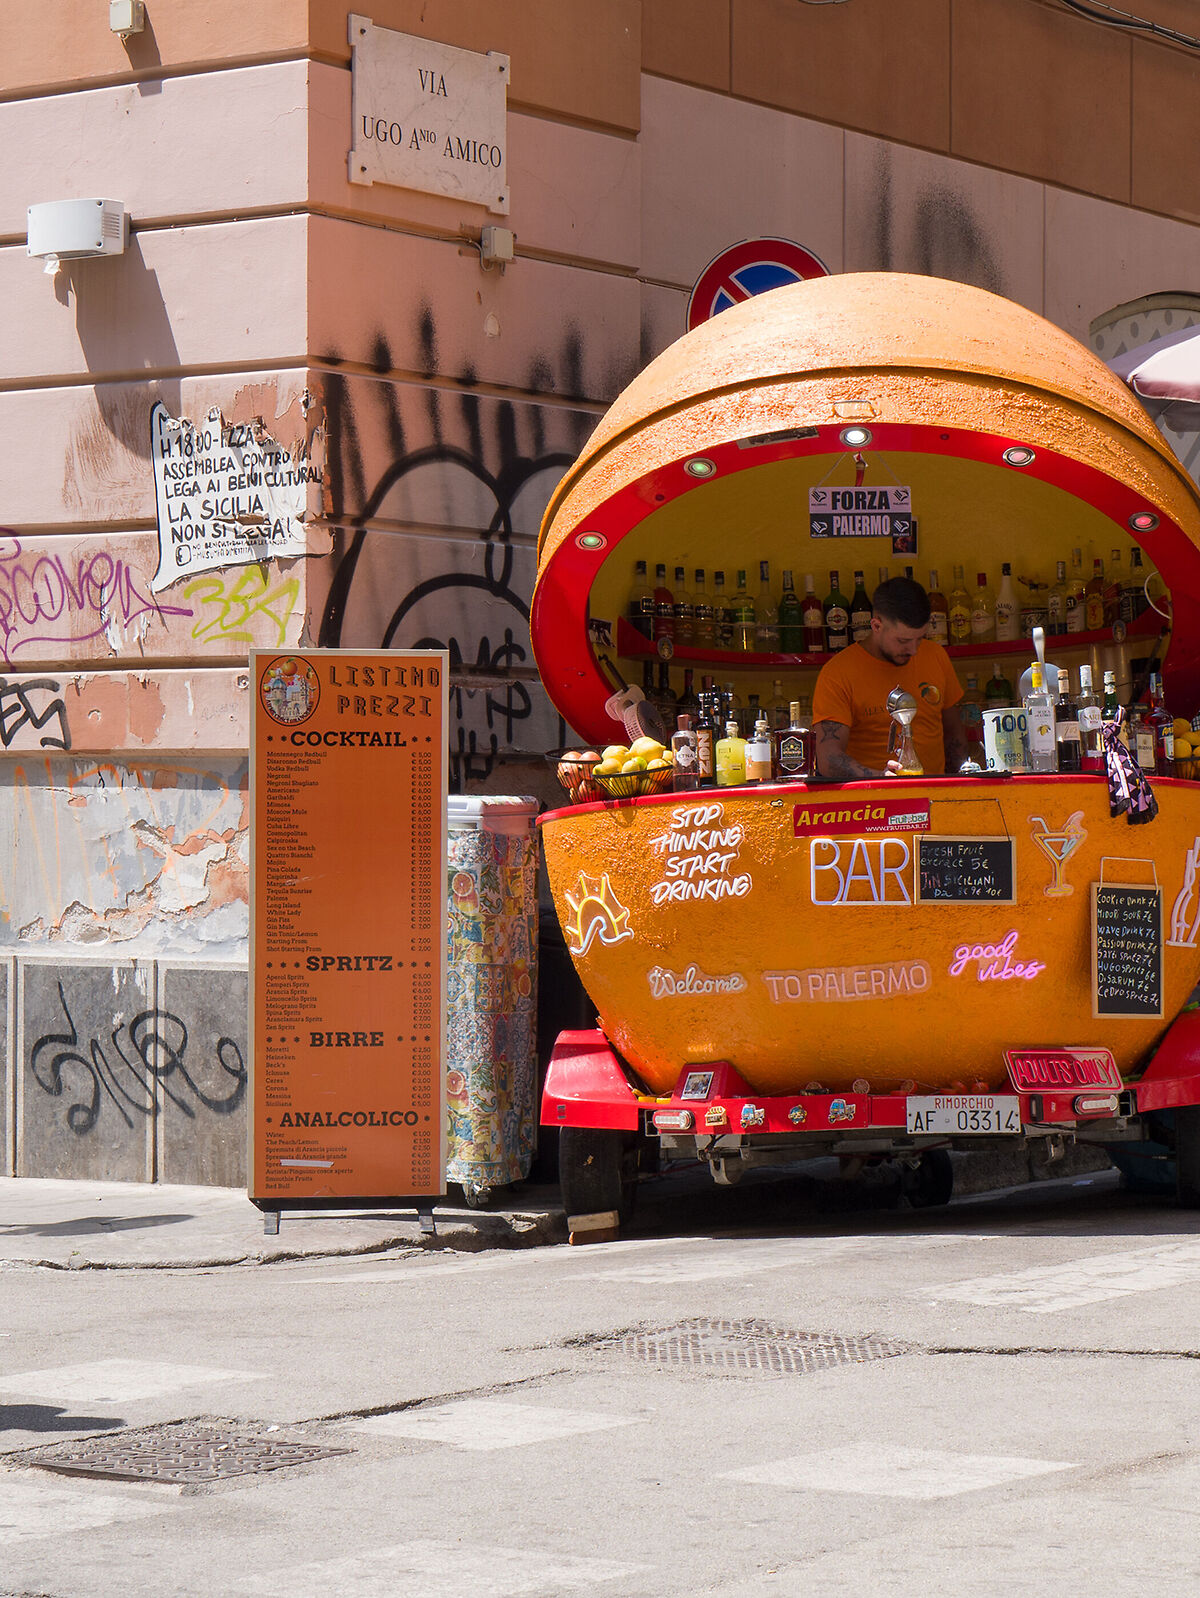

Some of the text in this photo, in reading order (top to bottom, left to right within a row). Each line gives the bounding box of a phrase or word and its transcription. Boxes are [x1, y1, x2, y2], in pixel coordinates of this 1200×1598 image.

[418, 68, 448, 97] VIA
[362, 115, 402, 145] UGO
[443, 136, 502, 168] AMICO
[163, 455, 236, 481] ASSEMBLEA
[164, 480, 201, 500] LEGA
[831, 490, 891, 511] FORZA
[167, 494, 264, 523] LA SICILIA
[171, 524, 206, 544] NON
[832, 514, 891, 536] PALERMO
[329, 665, 440, 688] LISTINO
[337, 694, 432, 717] PREZZI
[992, 714, 1027, 733] 100
[290, 731, 407, 747] COCKTAIL
[671, 804, 721, 829] STOP
[797, 804, 886, 827] Arancia
[650, 825, 743, 853] THINKING
[665, 852, 737, 877] START
[810, 838, 911, 905] BAR
[651, 874, 750, 904] DRINKING
[306, 956, 393, 972] SPRITZ
[949, 929, 1019, 977] good
[650, 964, 745, 998] Welcome
[766, 963, 928, 1000] TO PALERMO
[978, 957, 1046, 982] vibes
[309, 1031, 384, 1047] BIRRE
[1016, 1058, 1114, 1084] ADULTS ONLY
[935, 1097, 994, 1109] RIMORCHIO
[279, 1111, 419, 1127] ANALCOLICO
[914, 1110, 1015, 1131] AF 03314
